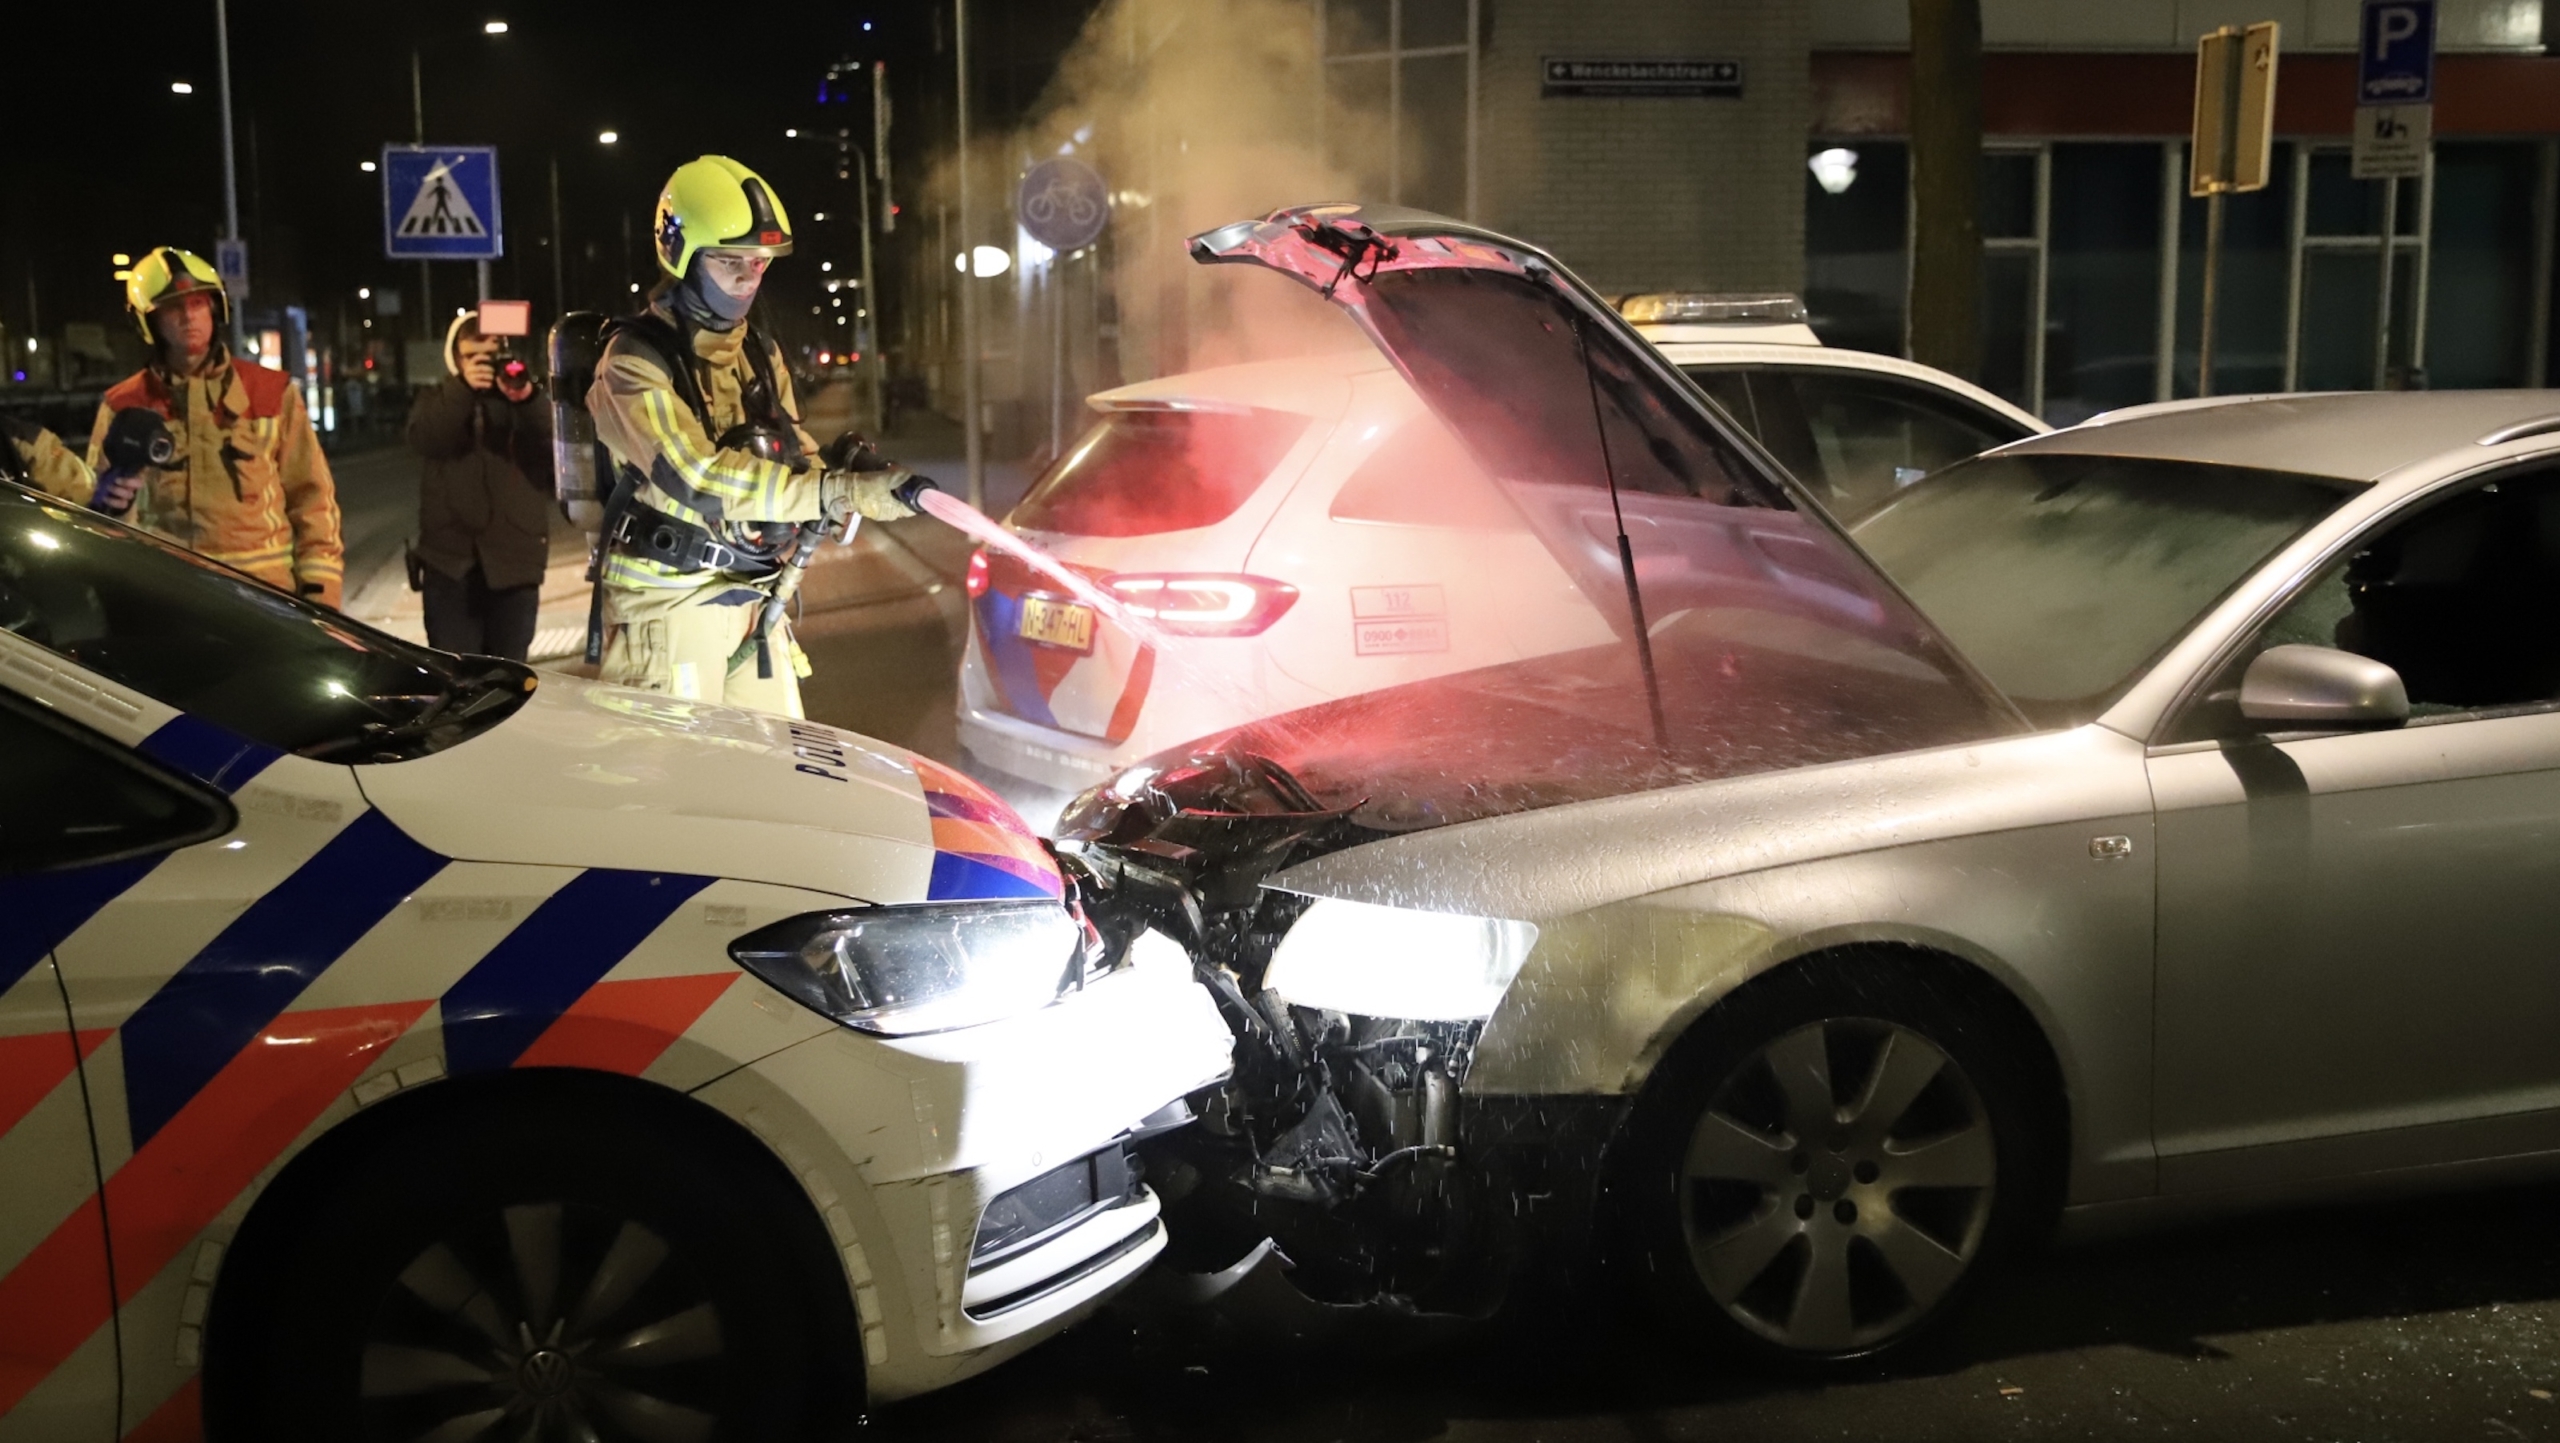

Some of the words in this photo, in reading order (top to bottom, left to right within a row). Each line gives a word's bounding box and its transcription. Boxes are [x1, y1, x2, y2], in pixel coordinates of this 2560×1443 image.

[2376, 7, 2419, 62] P
[1385, 591, 1411, 608] 112
[1363, 630, 1393, 643] 0900
[787, 721, 849, 783] POLITIE
